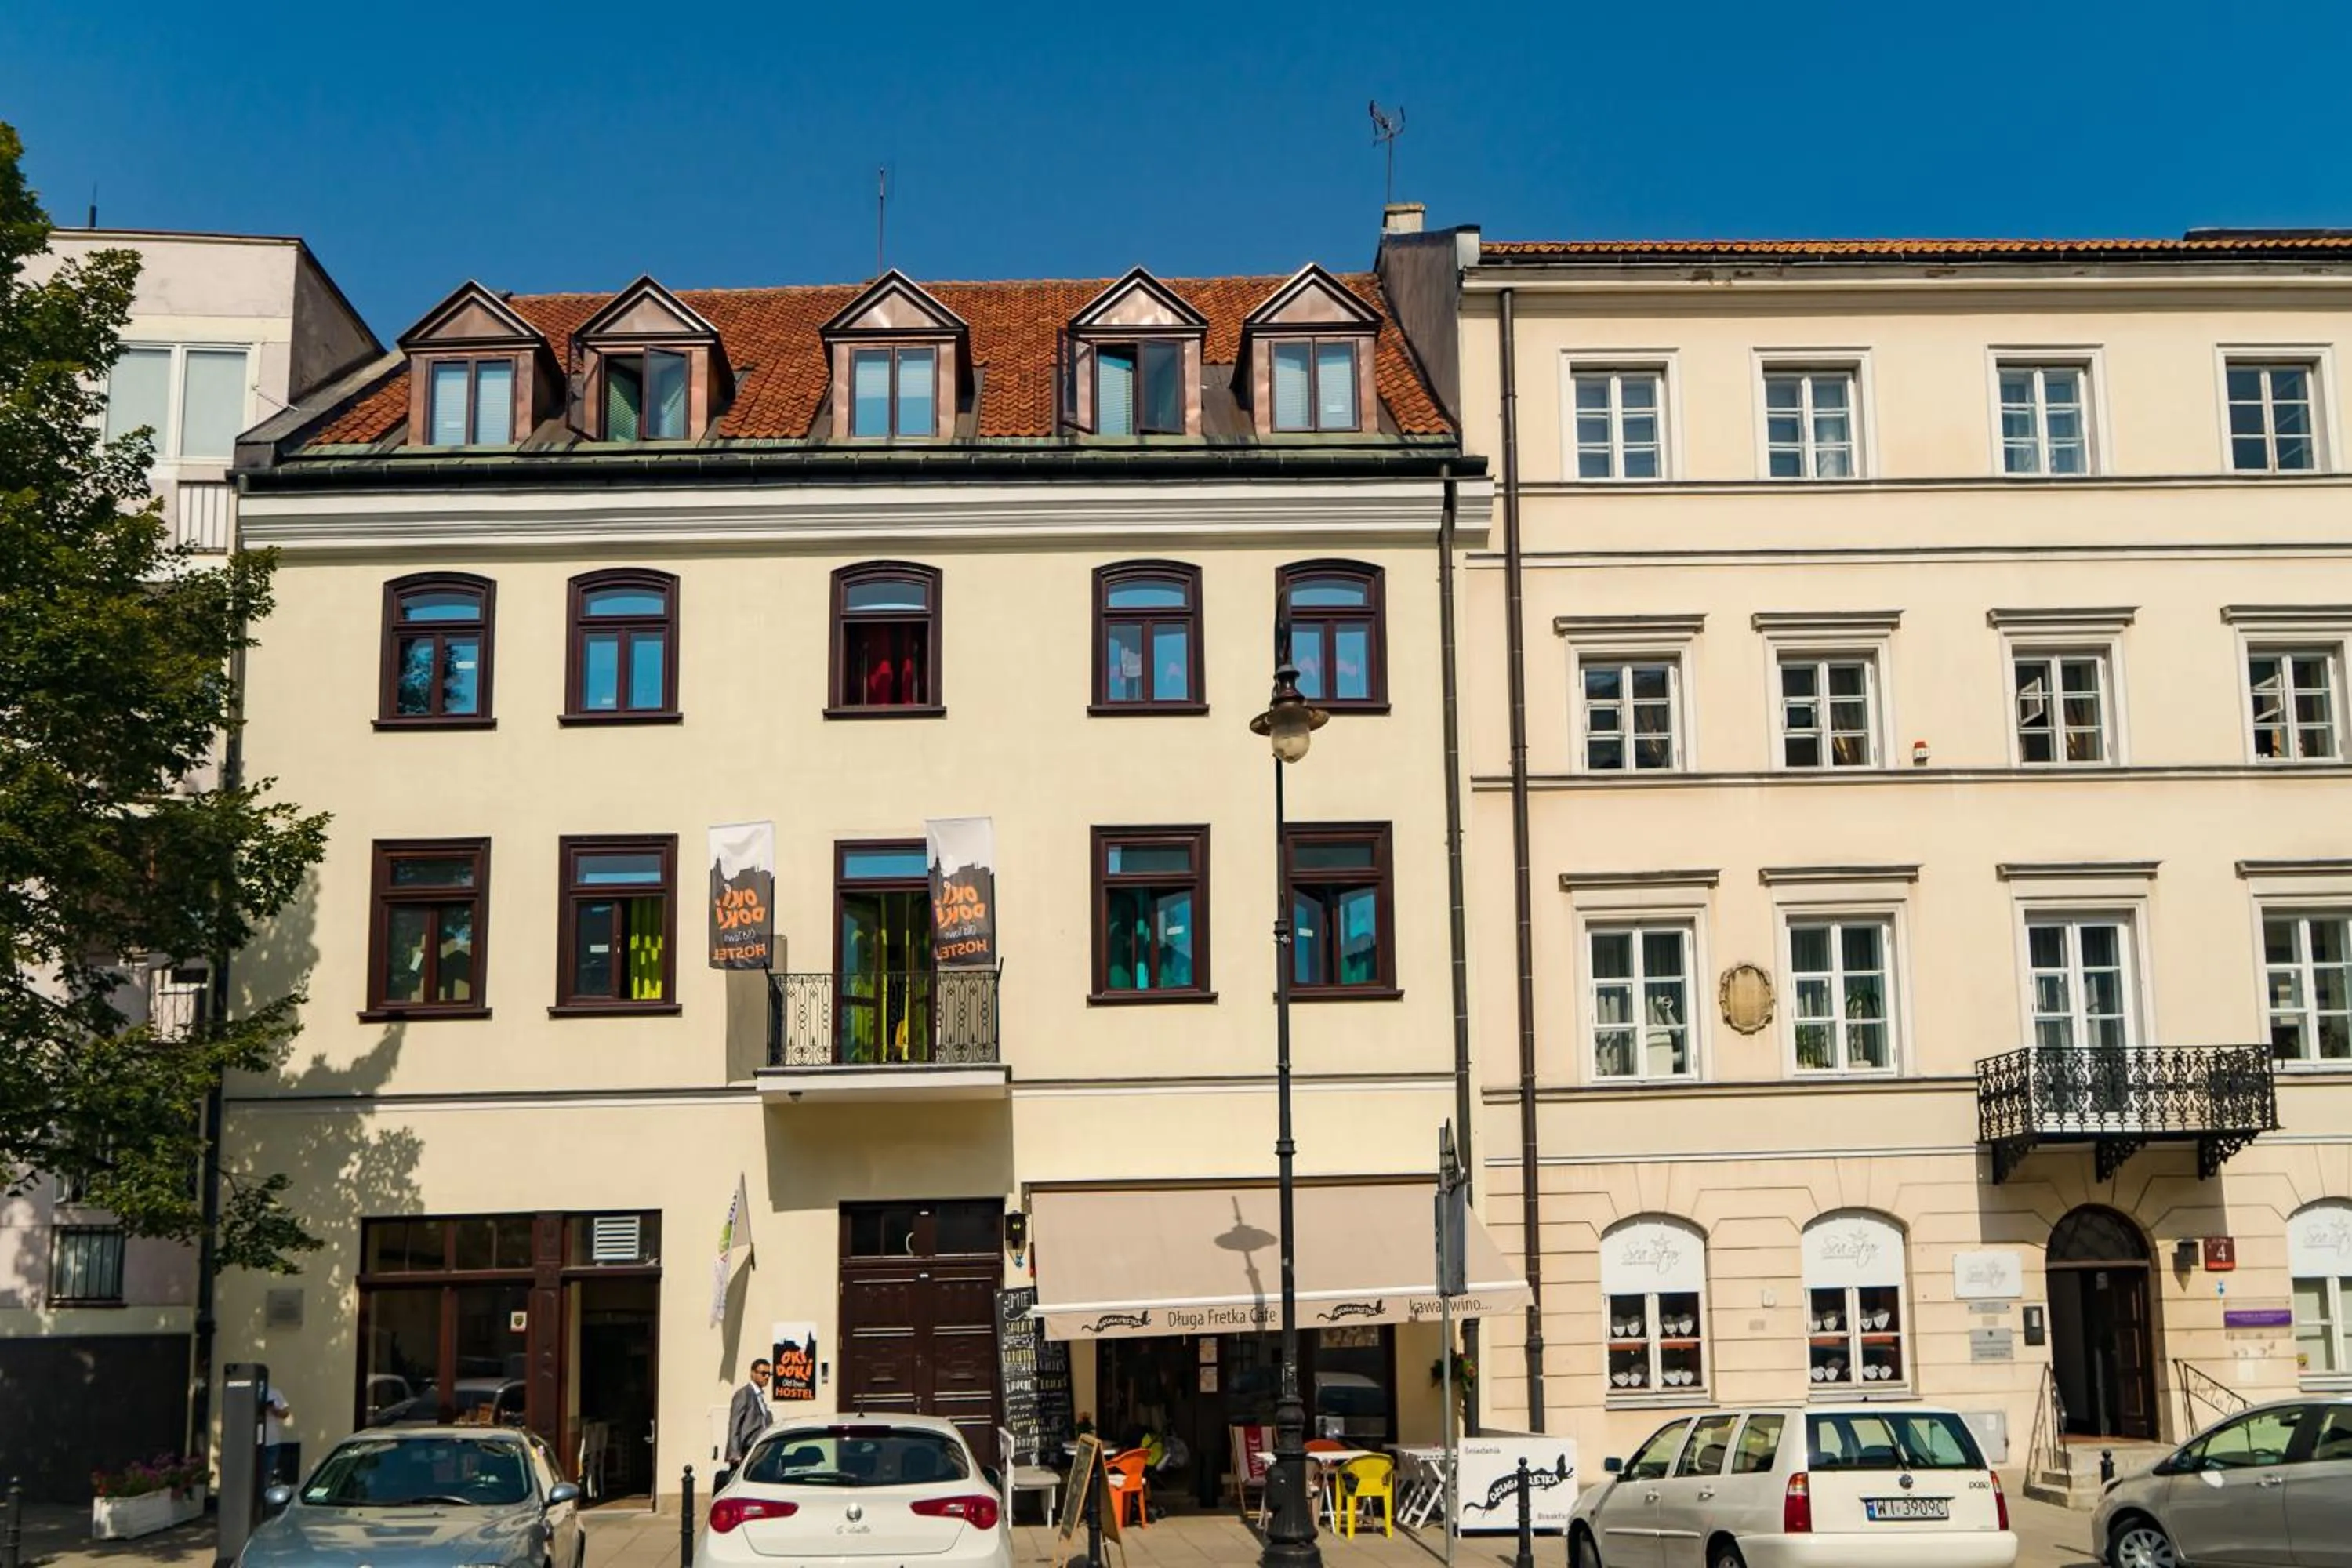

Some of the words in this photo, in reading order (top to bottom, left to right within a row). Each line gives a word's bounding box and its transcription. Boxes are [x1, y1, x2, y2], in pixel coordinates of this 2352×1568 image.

[2216, 1244, 2227, 1261] 4
[1167, 1311, 1205, 1330] Długa
[1207, 1308, 1247, 1326] Fretka
[775, 1386, 814, 1399] HOSTEL
[1528, 1473, 1560, 1486] RETKA
